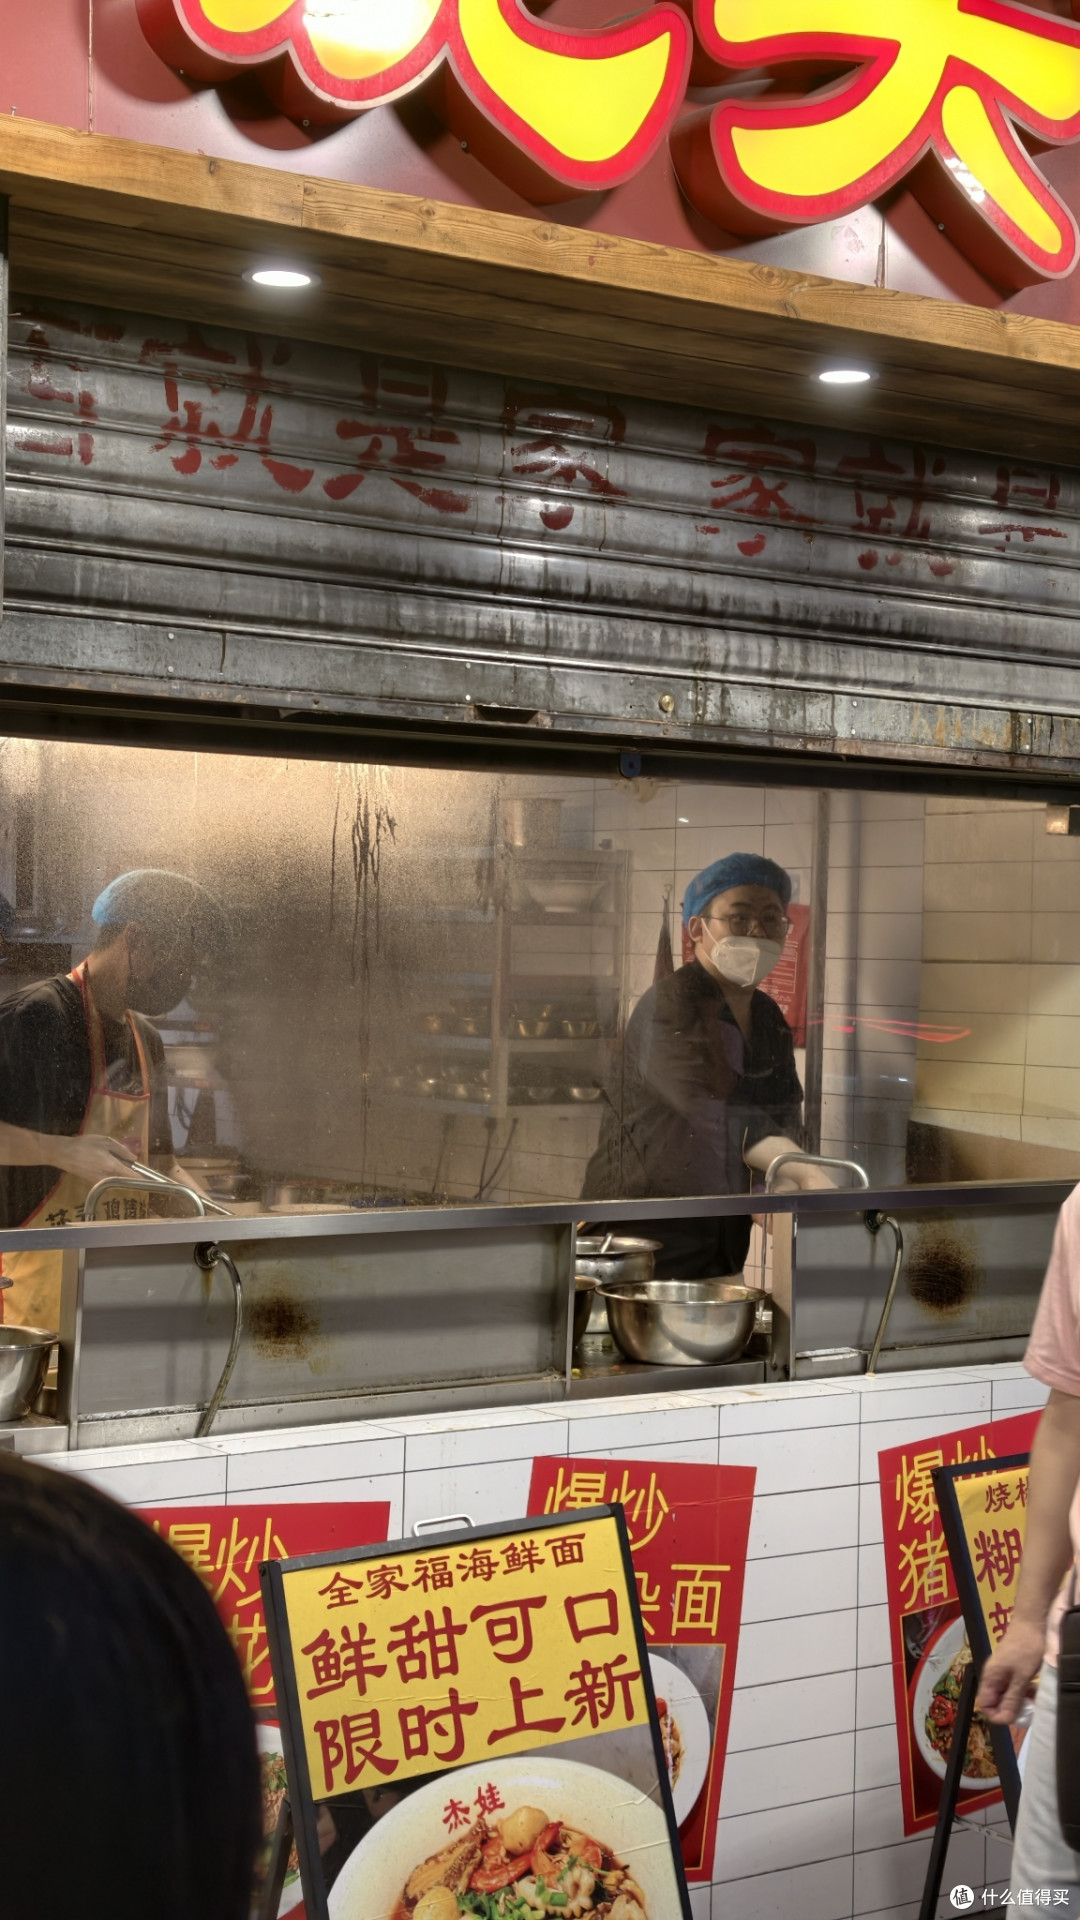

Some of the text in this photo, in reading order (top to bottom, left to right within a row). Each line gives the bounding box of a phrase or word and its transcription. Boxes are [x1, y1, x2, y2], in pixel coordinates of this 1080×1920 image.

[317, 1532, 586, 1610] 全家福海鲜面
[301, 1588, 620, 1700] 鲜甜可口
[313, 1654, 642, 1793] 限时上新
[442, 1782, 506, 1835] 杰娃
